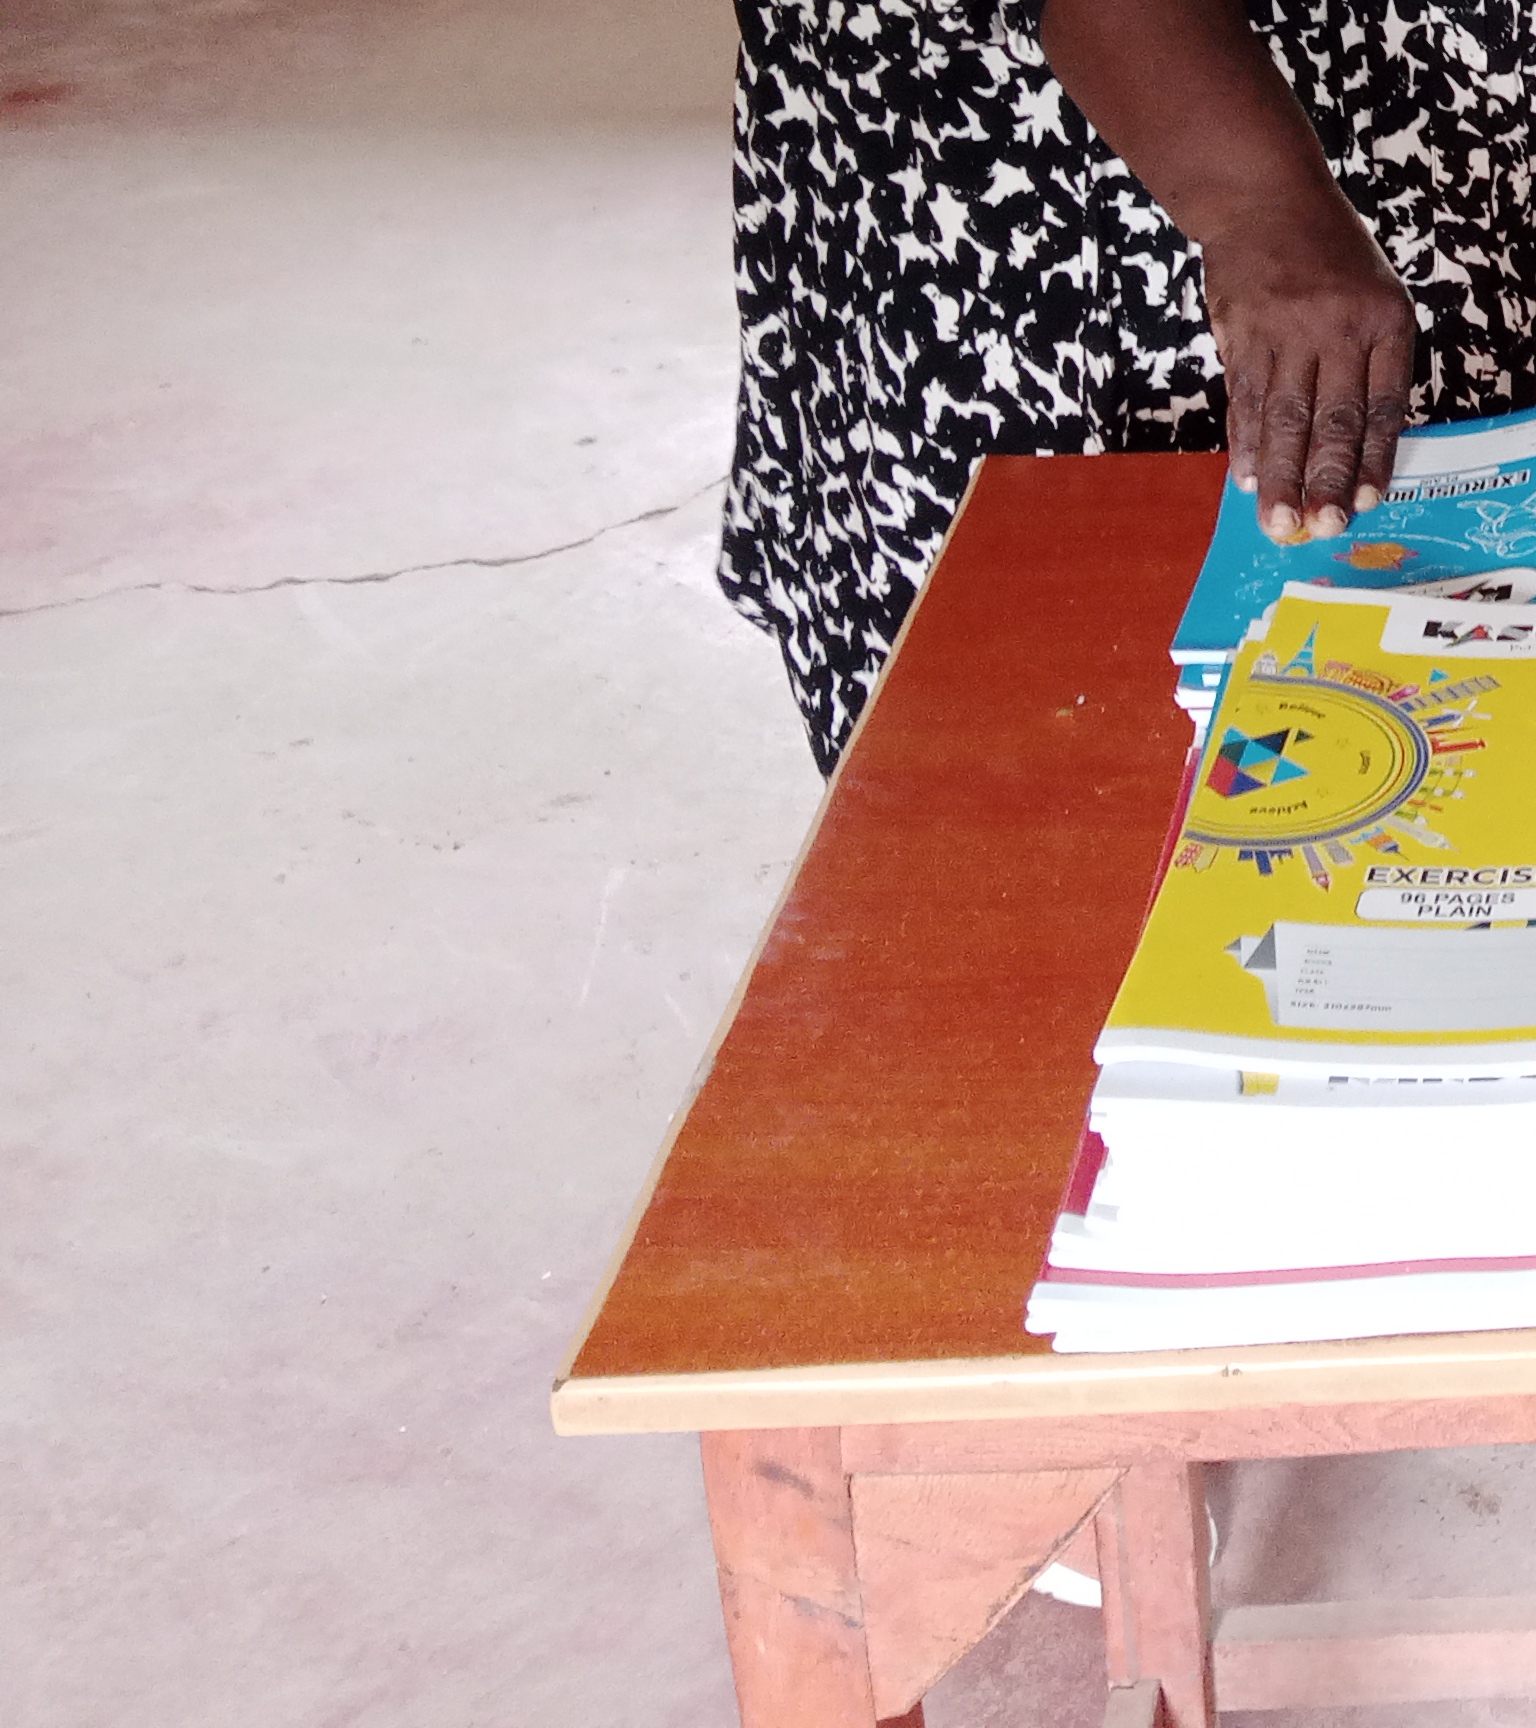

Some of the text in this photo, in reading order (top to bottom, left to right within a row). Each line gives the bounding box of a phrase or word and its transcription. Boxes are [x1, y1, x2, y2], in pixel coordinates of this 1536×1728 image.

[1419, 468, 1531, 501] EXERCISE
[1399, 891, 1515, 905] 96 PAGES
[1417, 905, 1492, 918] PLAIN
